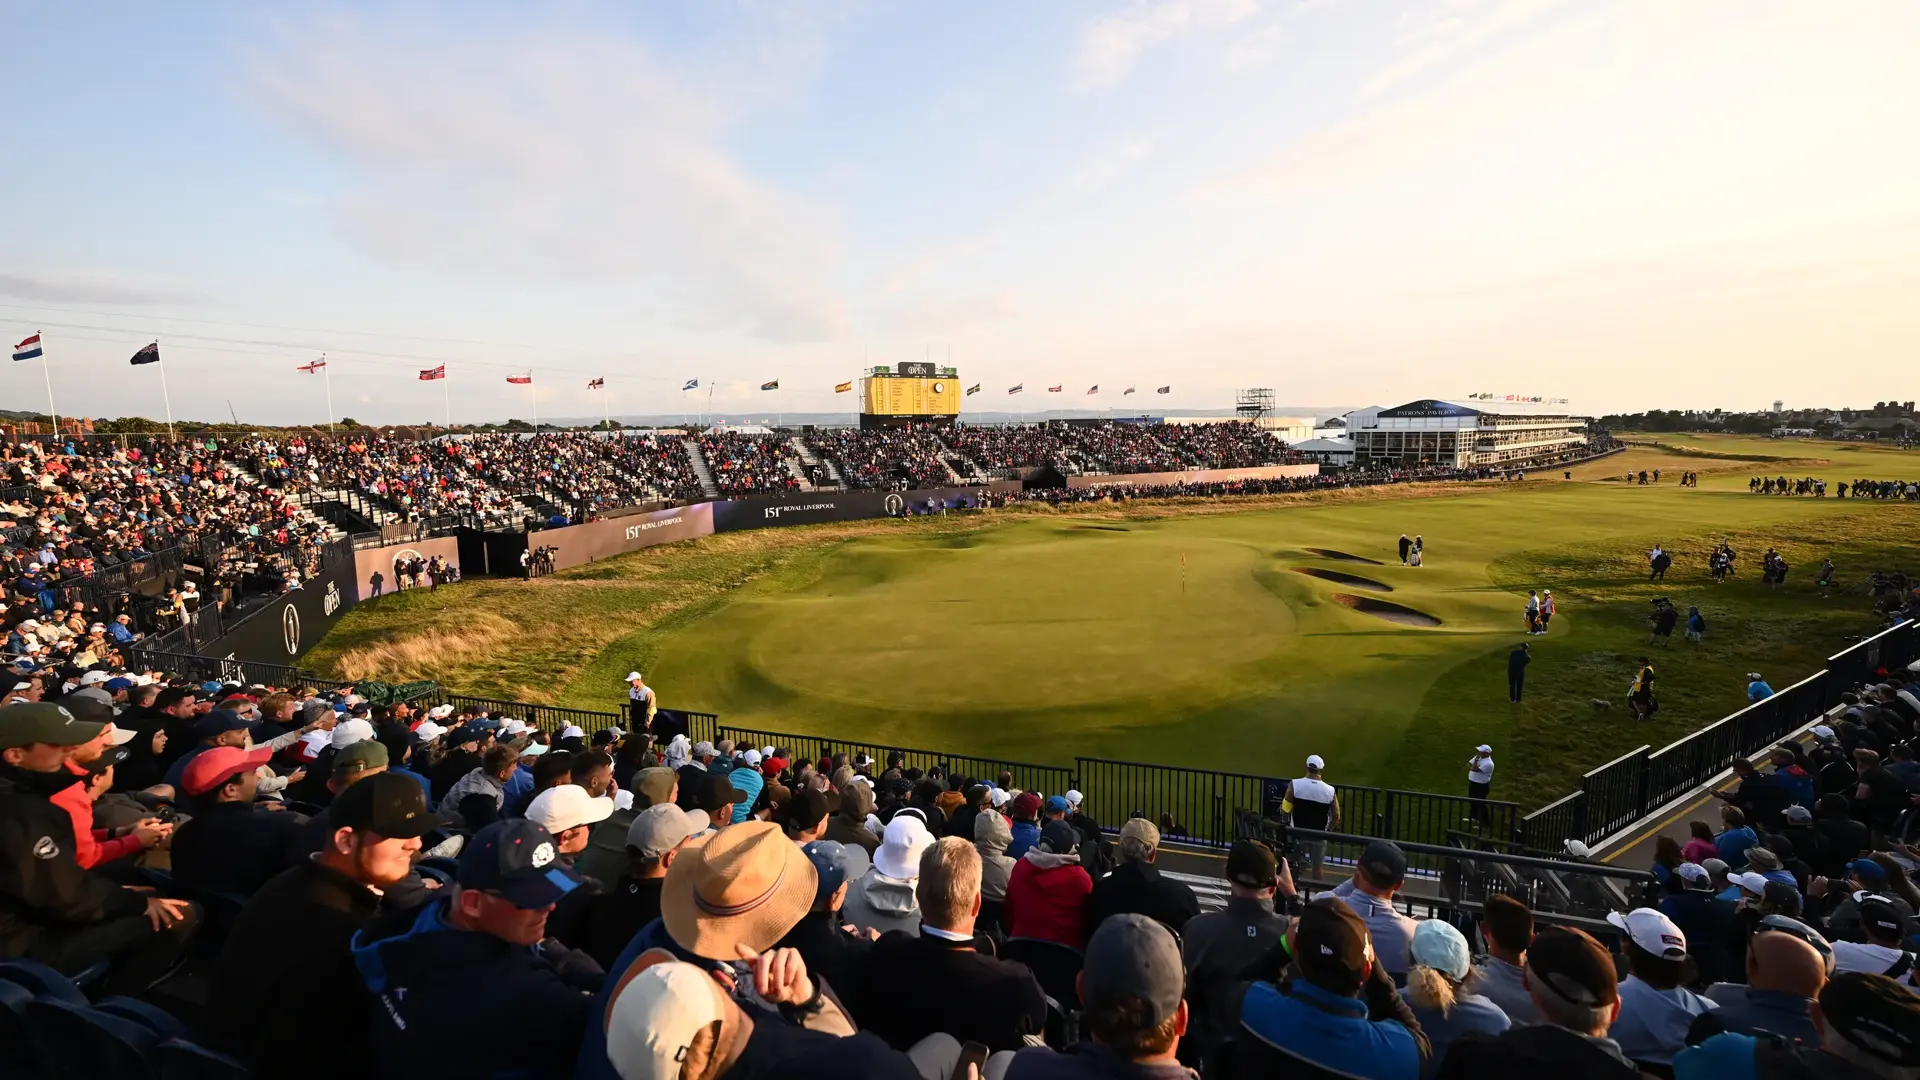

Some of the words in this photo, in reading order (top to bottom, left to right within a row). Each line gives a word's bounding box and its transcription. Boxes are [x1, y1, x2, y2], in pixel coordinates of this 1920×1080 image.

[907, 366, 927, 375] OPEN
[803, 502, 836, 511] LIVERPOOL
[641, 521, 658, 531] ROYAL
[657, 516, 684, 527] LIVERPOOL
[324, 587, 341, 616] OPEN
[1247, 926, 1257, 937] FJ
